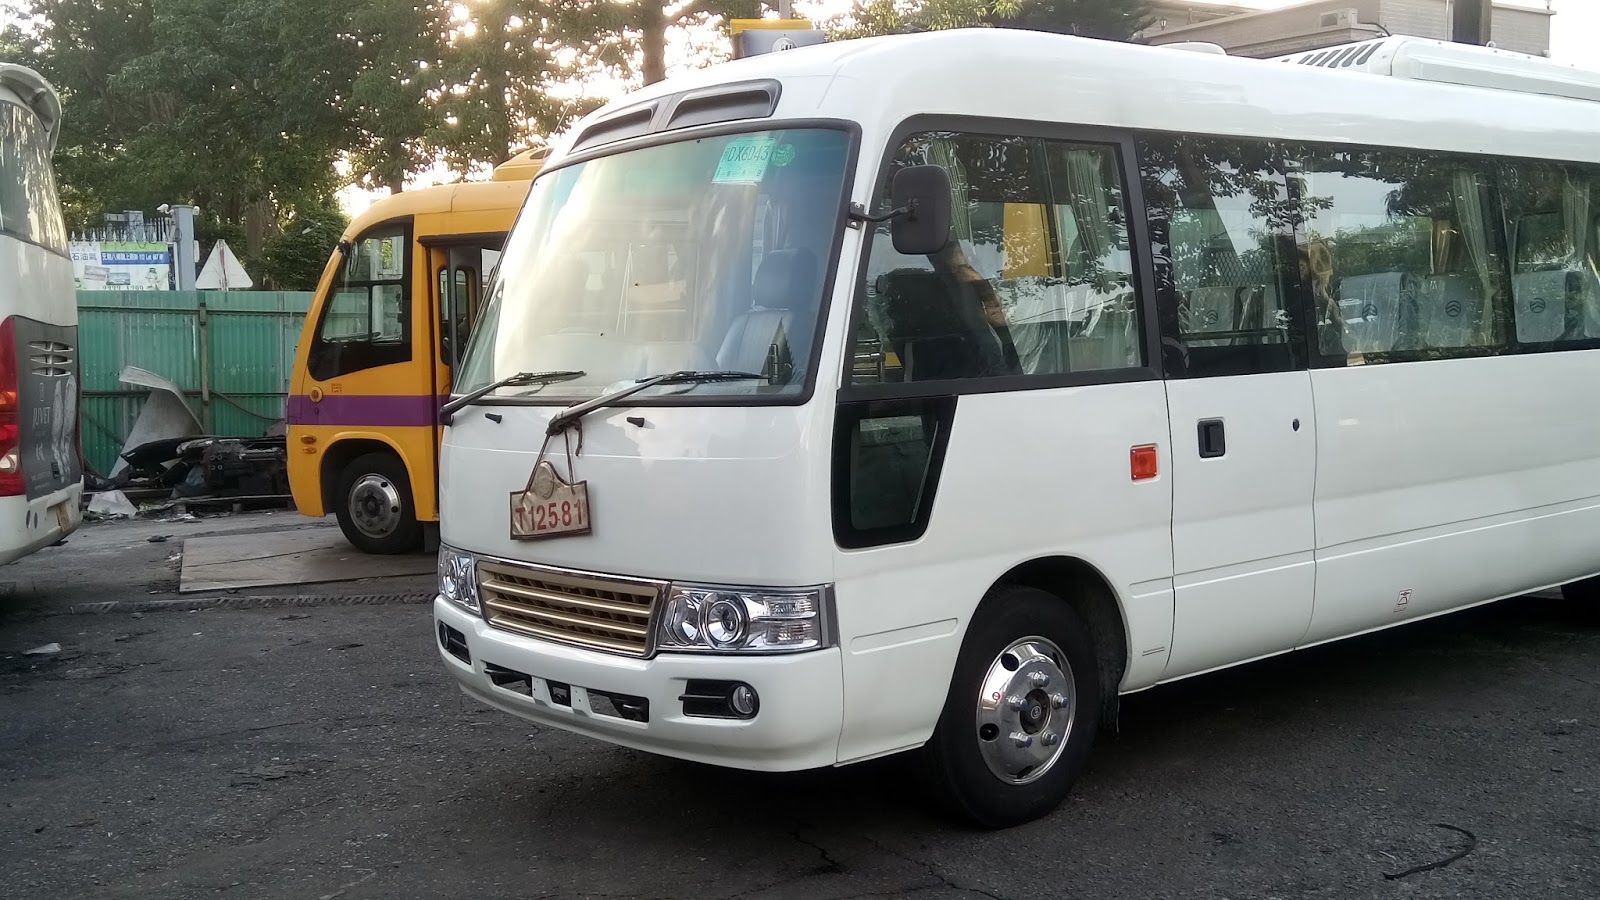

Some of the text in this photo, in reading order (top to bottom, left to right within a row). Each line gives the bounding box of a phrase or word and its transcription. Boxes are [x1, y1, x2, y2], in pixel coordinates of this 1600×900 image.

[71, 252, 97, 261] 石油氣
[515, 498, 583, 532] T12581
